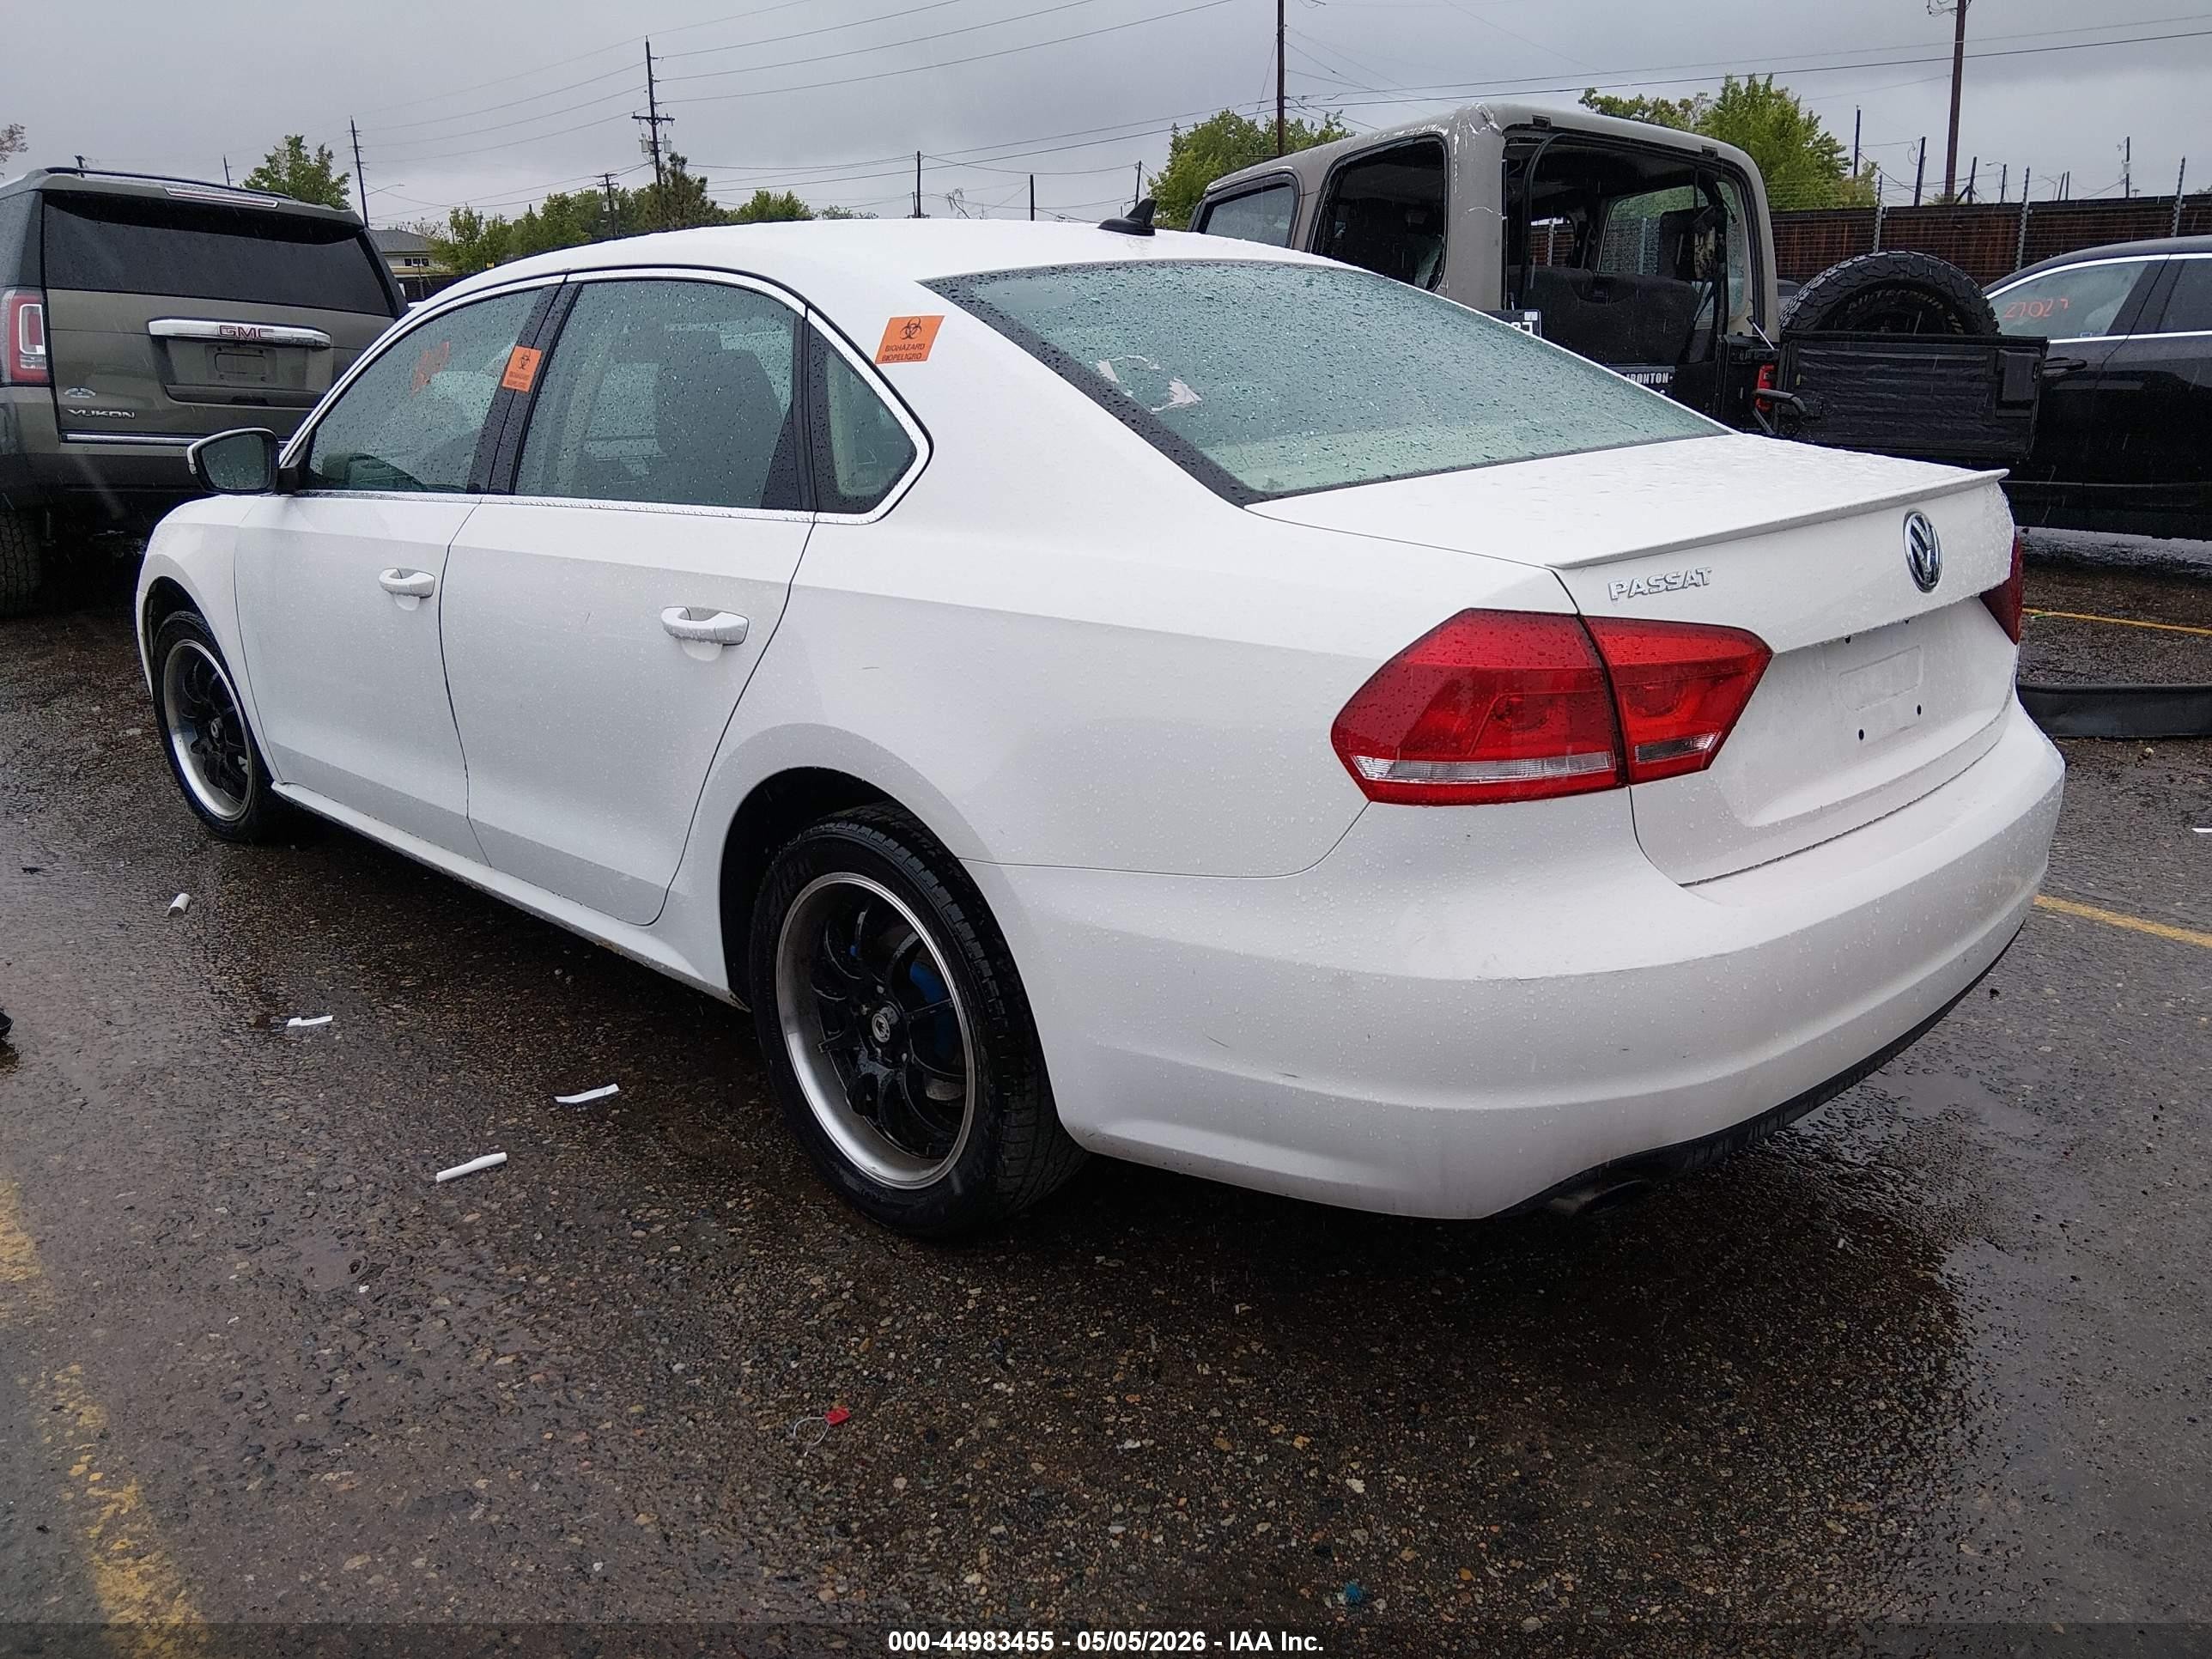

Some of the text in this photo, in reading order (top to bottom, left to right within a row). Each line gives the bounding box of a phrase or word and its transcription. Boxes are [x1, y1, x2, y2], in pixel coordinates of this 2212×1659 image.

[219, 325, 275, 339] GMC
[884, 343, 926, 352] BIOHAZARD
[881, 352, 922, 362] BIOPELIGRO
[68, 409, 136, 419] YUKON
[1608, 567, 1712, 601] PASSAT
